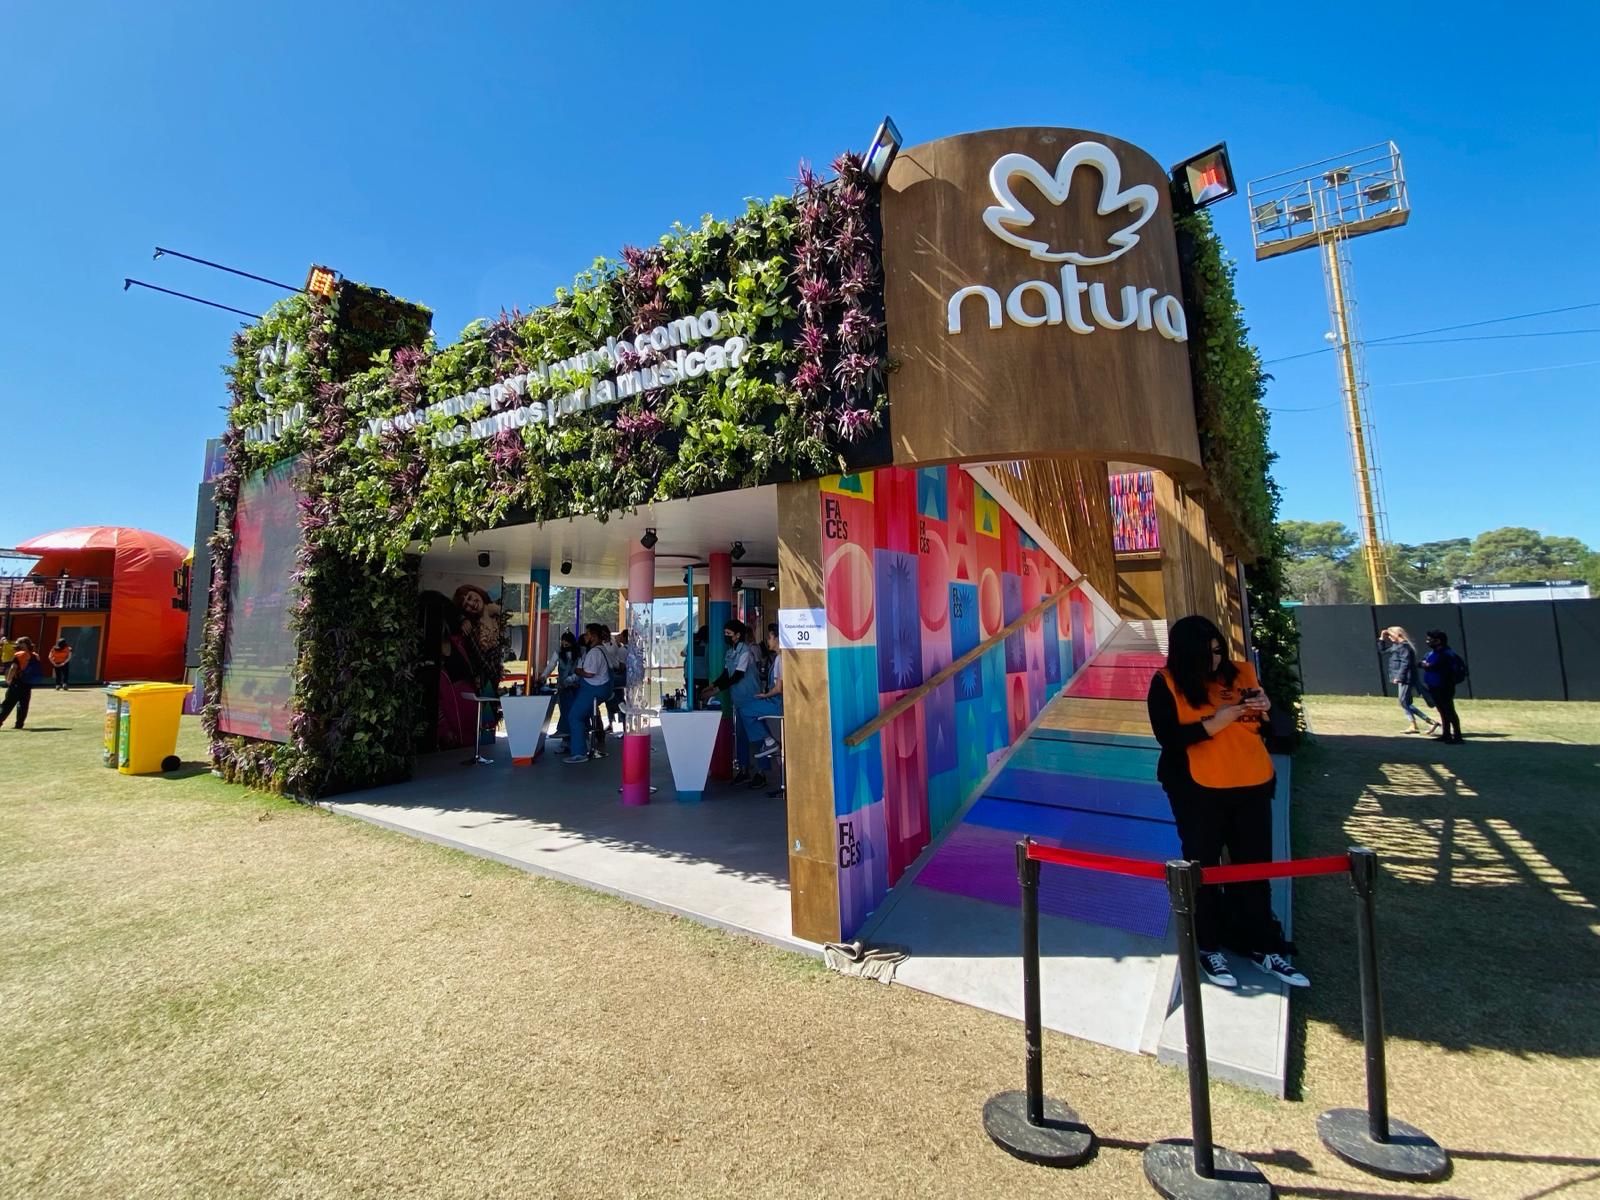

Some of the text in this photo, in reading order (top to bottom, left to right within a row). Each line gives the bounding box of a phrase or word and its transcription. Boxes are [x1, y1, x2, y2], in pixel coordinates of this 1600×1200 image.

[947, 263, 1188, 343] natura
[634, 310, 722, 357] como
[589, 376, 618, 409] la
[797, 630, 810, 641] 30
